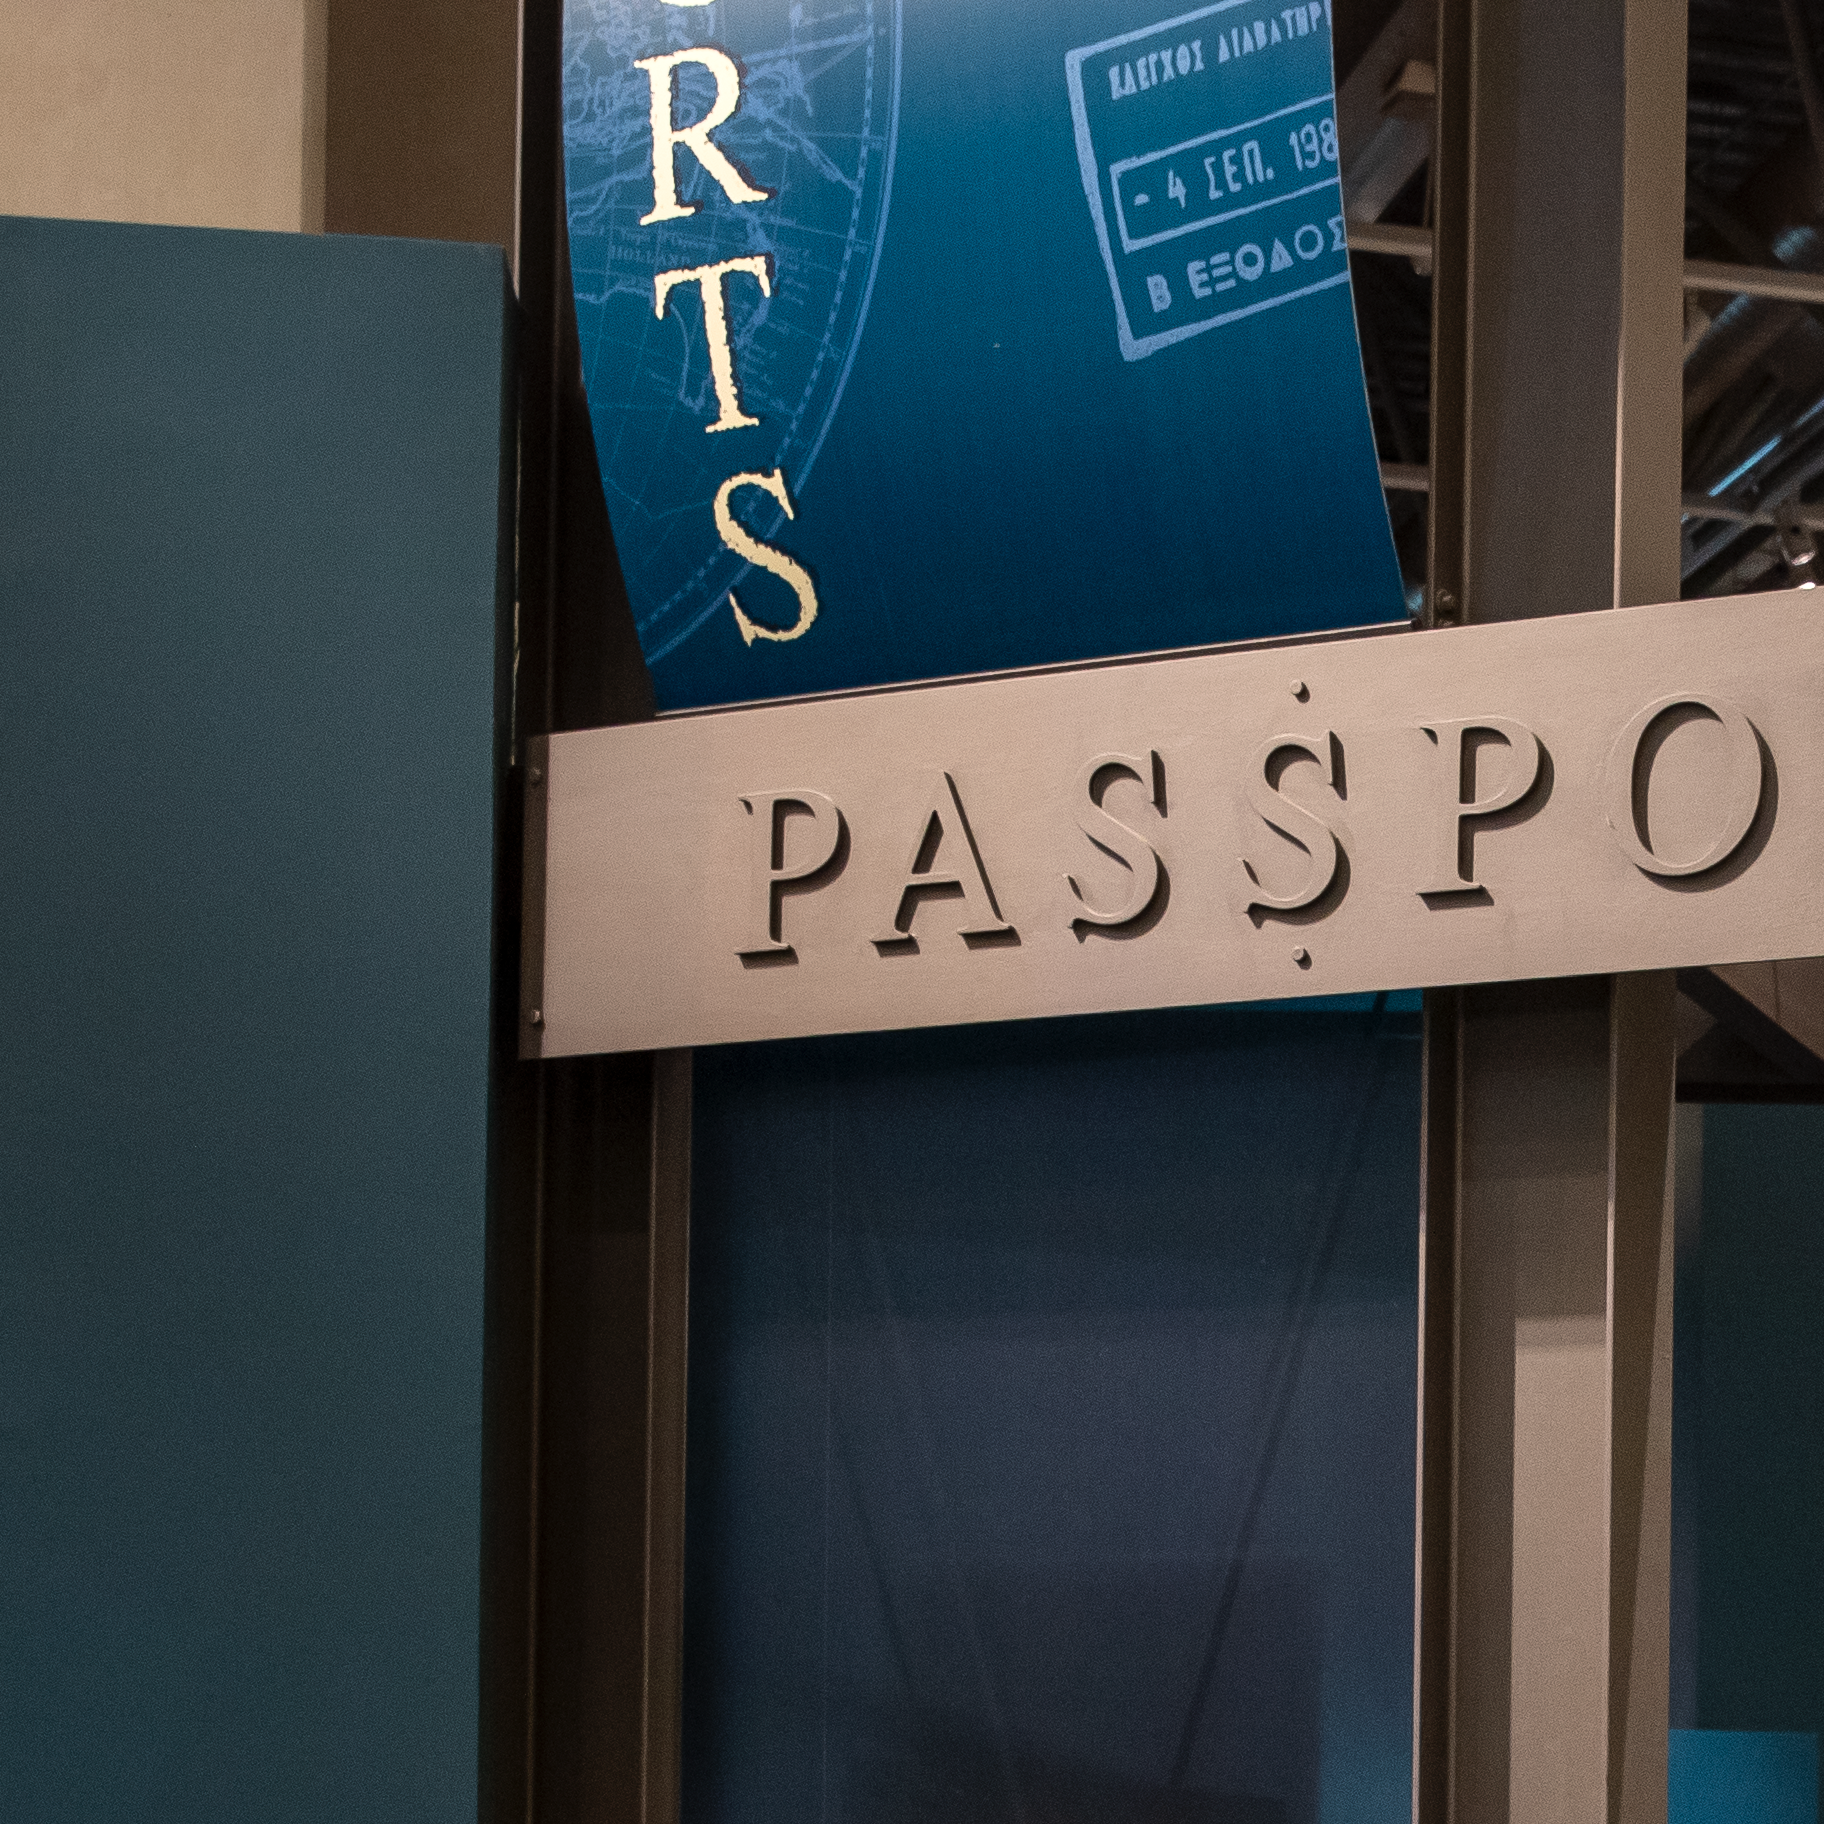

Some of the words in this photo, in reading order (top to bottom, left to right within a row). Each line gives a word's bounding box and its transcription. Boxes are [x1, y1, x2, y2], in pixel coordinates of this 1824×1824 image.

[1167, 167, 1187, 210] 4
[1203, 140, 1275, 201] ΣΕΠ.
[1288, 117, 1340, 172] 198
[1186, 214, 1349, 300] ΕΞΟΔΟΣ
[634, 0, 820, 647] RTS
